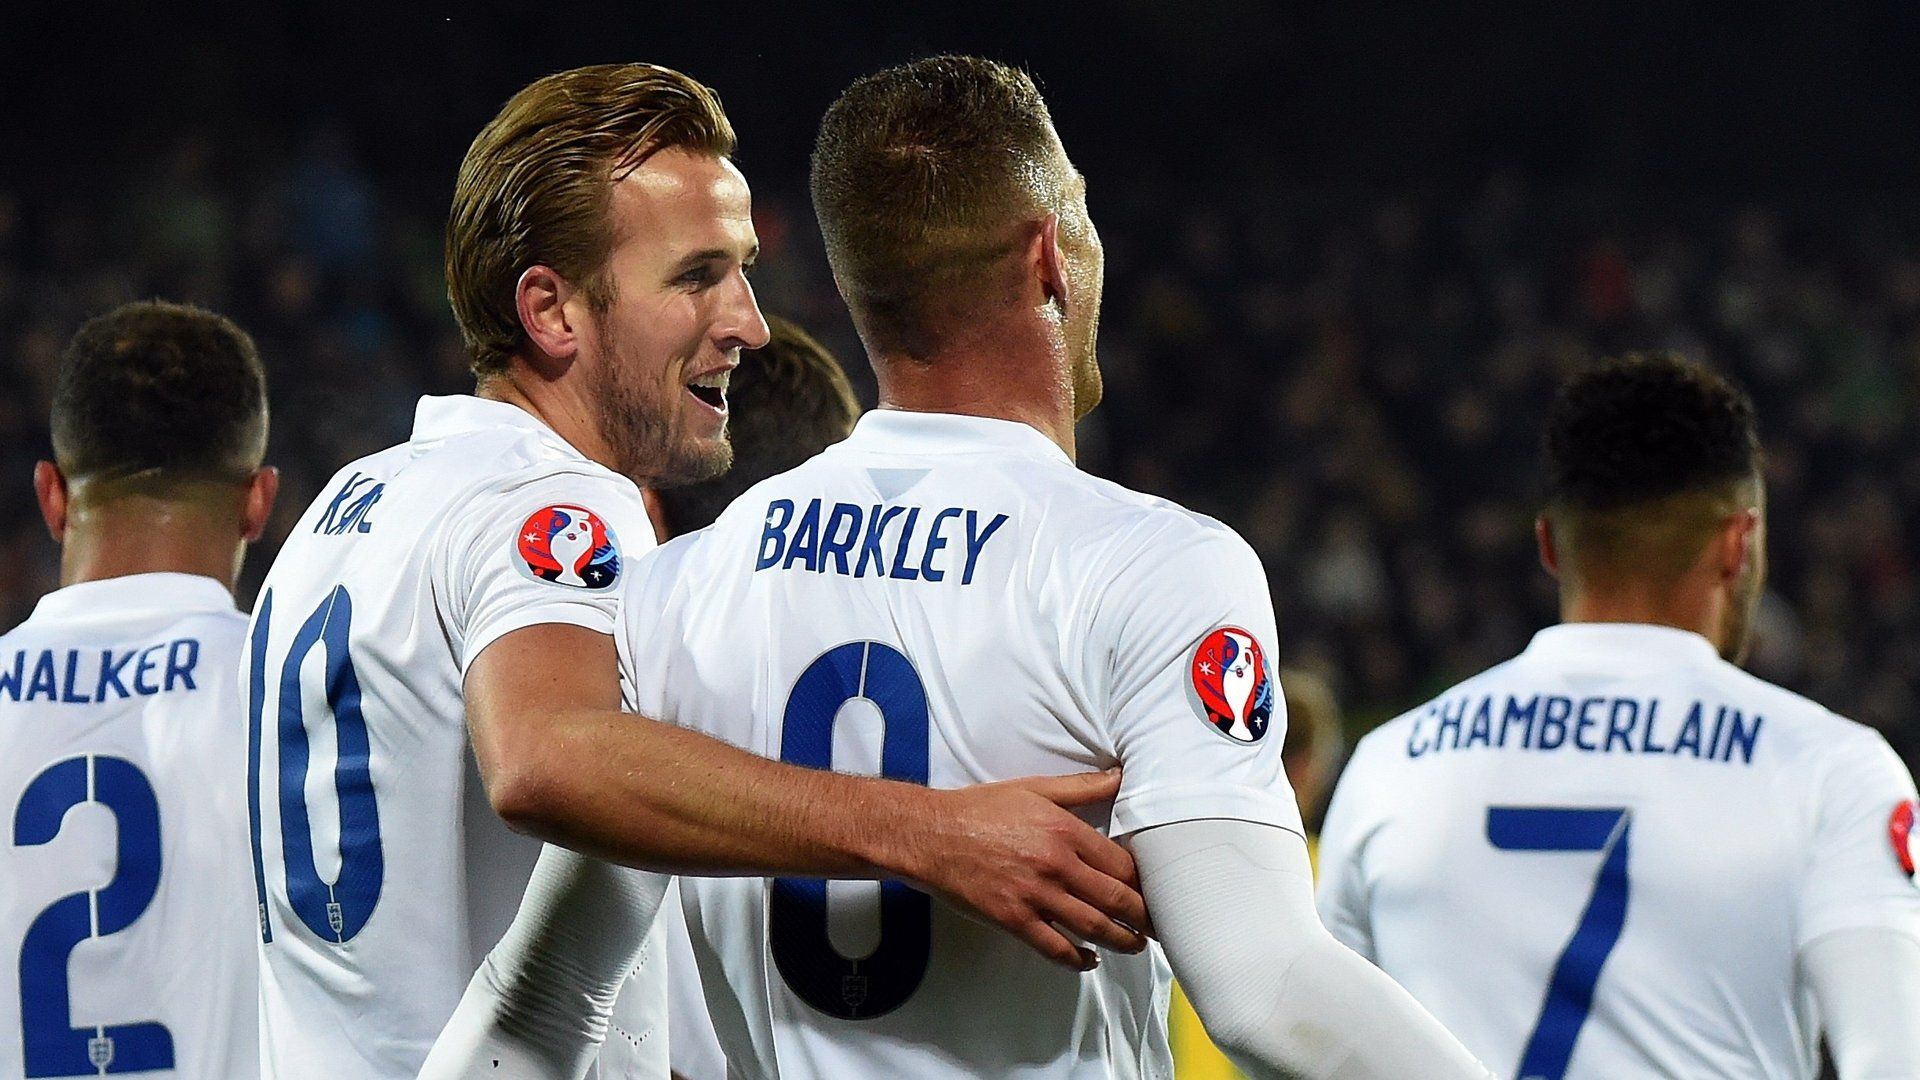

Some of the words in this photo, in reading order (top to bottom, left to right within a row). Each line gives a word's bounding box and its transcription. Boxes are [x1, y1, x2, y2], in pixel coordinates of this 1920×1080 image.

[755, 498, 1010, 585] BARKLEY
[0, 638, 200, 703] WALKER
[1407, 692, 1764, 766] CHAMBERLAIN
[247, 583, 384, 944] 10
[13, 753, 176, 1079] 2
[1486, 806, 1632, 1080] 7
